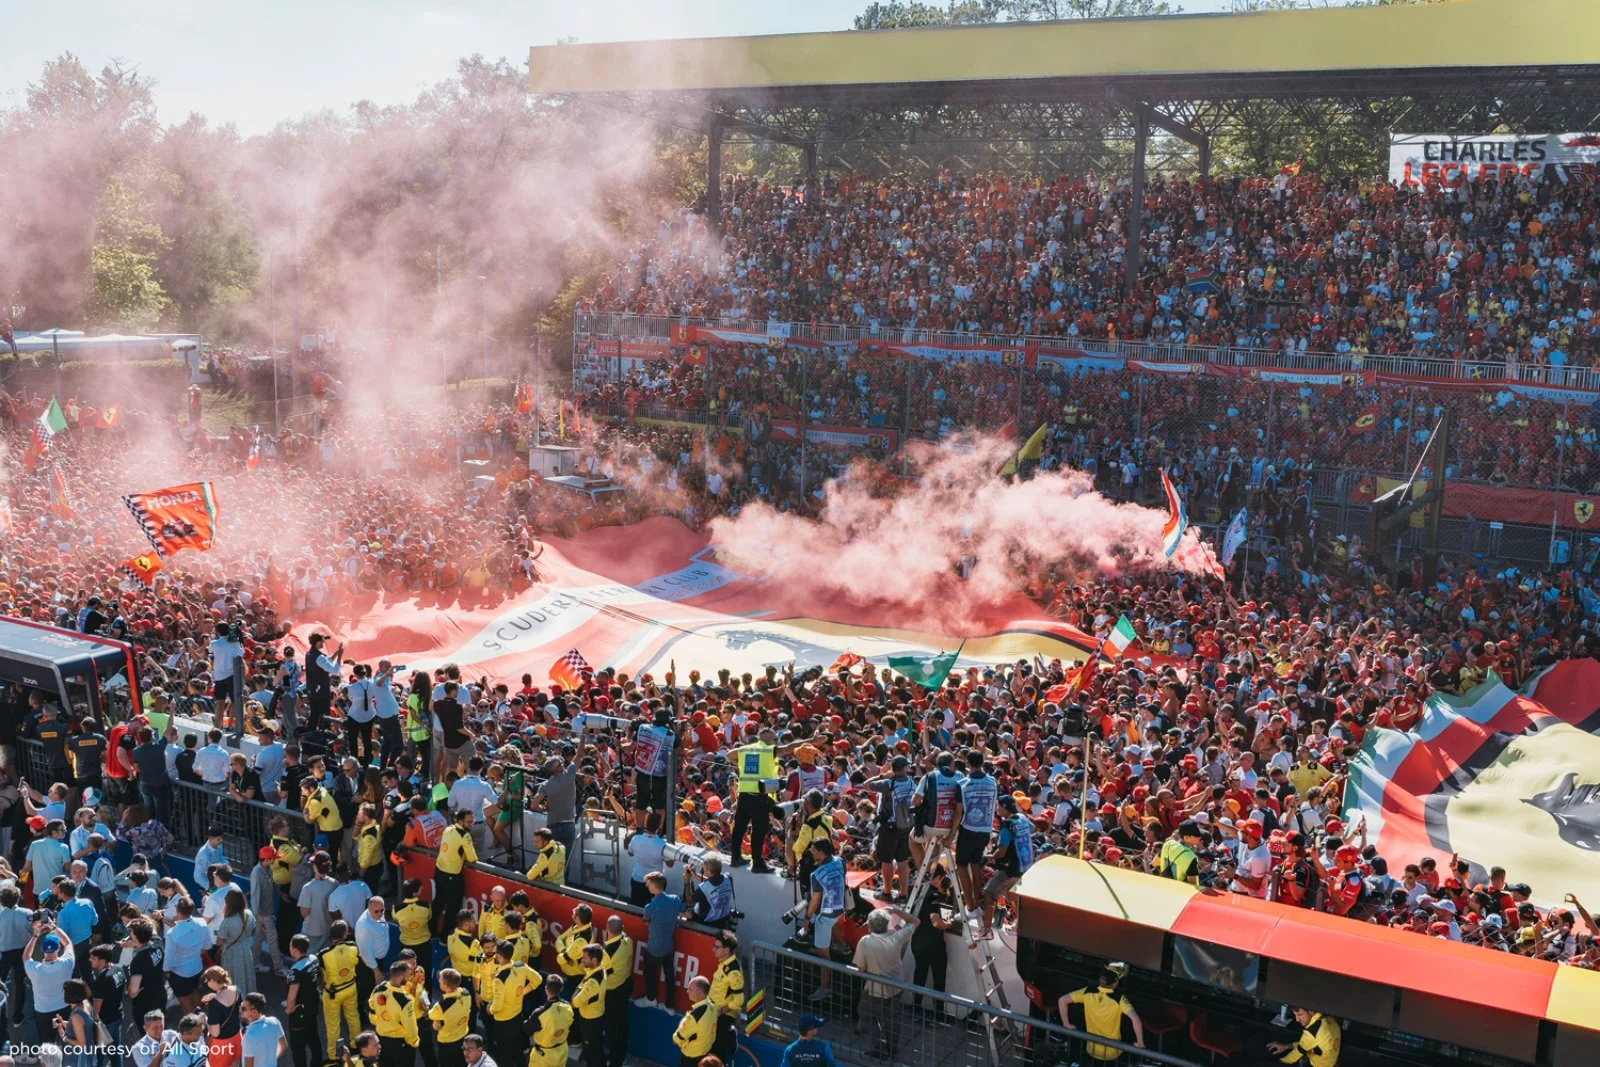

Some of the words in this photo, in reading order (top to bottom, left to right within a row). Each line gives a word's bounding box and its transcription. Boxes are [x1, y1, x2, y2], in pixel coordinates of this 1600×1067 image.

[1424, 141, 1546, 161] CHARLES
[145, 490, 201, 510] MONZA
[482, 591, 578, 650] SCUDERI
[664, 567, 709, 586] CLUB
